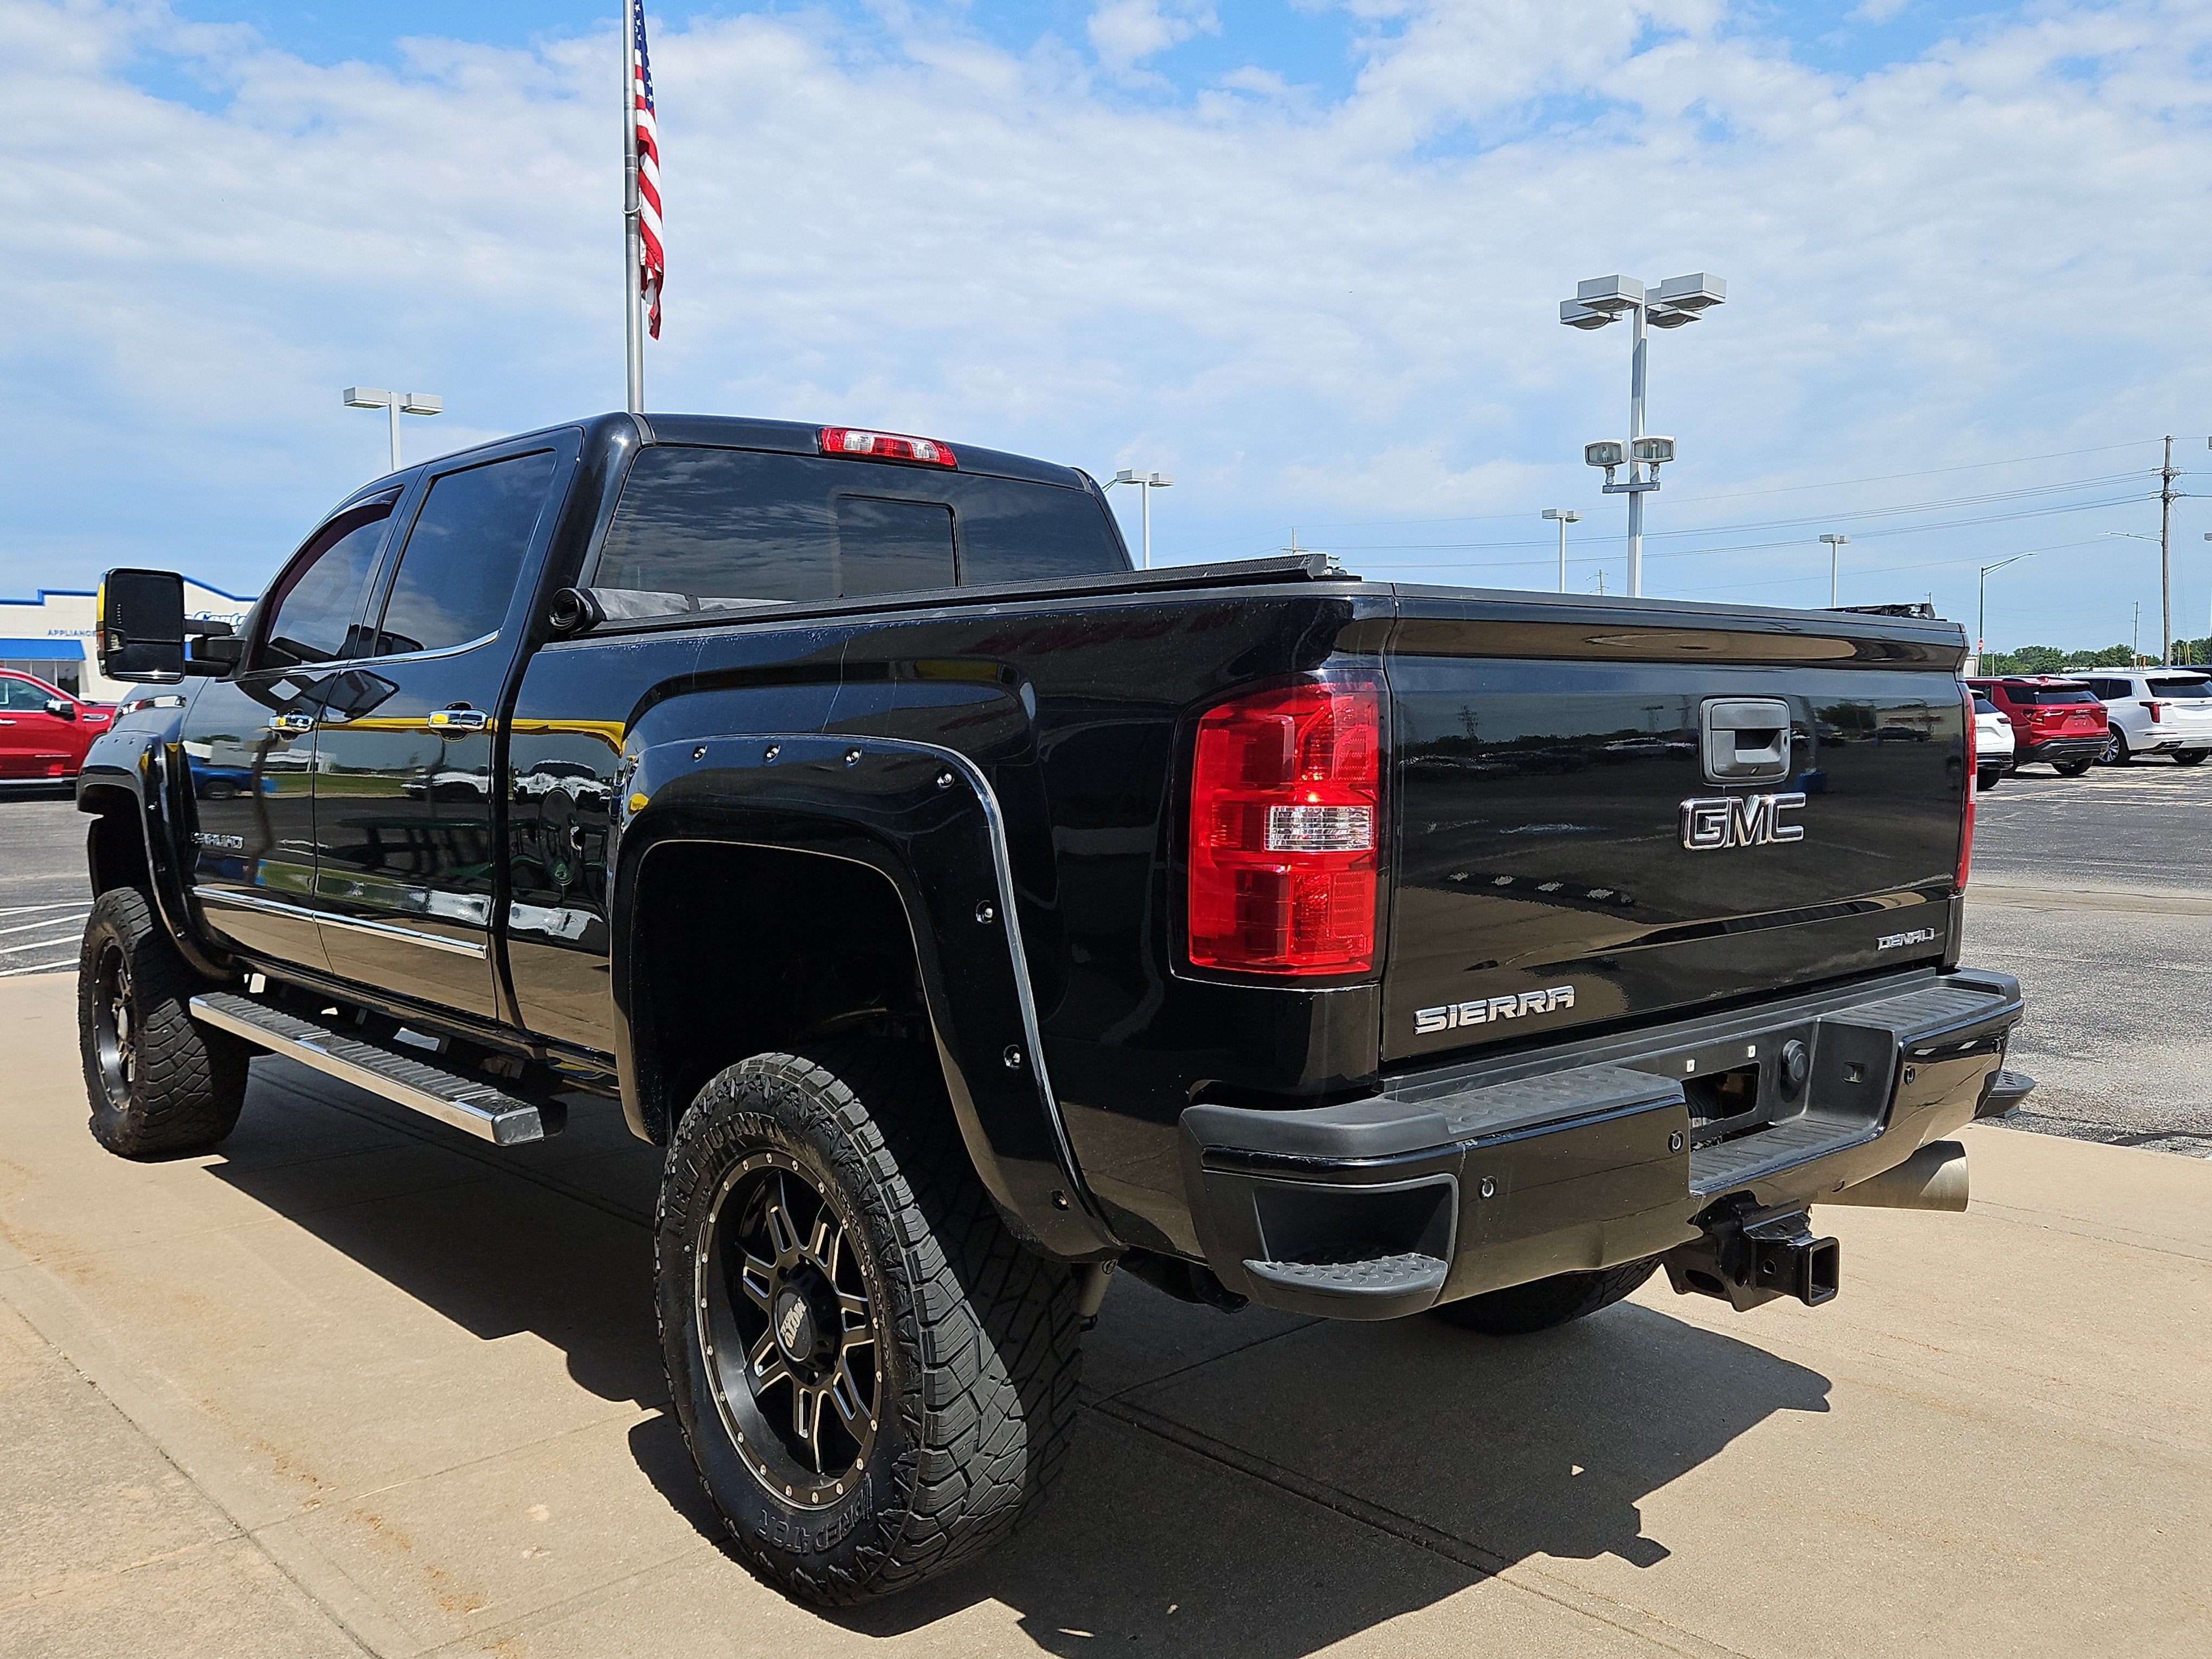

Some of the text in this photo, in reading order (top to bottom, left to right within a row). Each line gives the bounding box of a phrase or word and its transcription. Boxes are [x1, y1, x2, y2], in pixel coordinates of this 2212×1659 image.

[1679, 792, 1806, 850] GMC
[1876, 927, 1934, 950] DENALI
[1414, 985, 1574, 1036] SIERRA
[785, 1296, 807, 1348] MOTO
